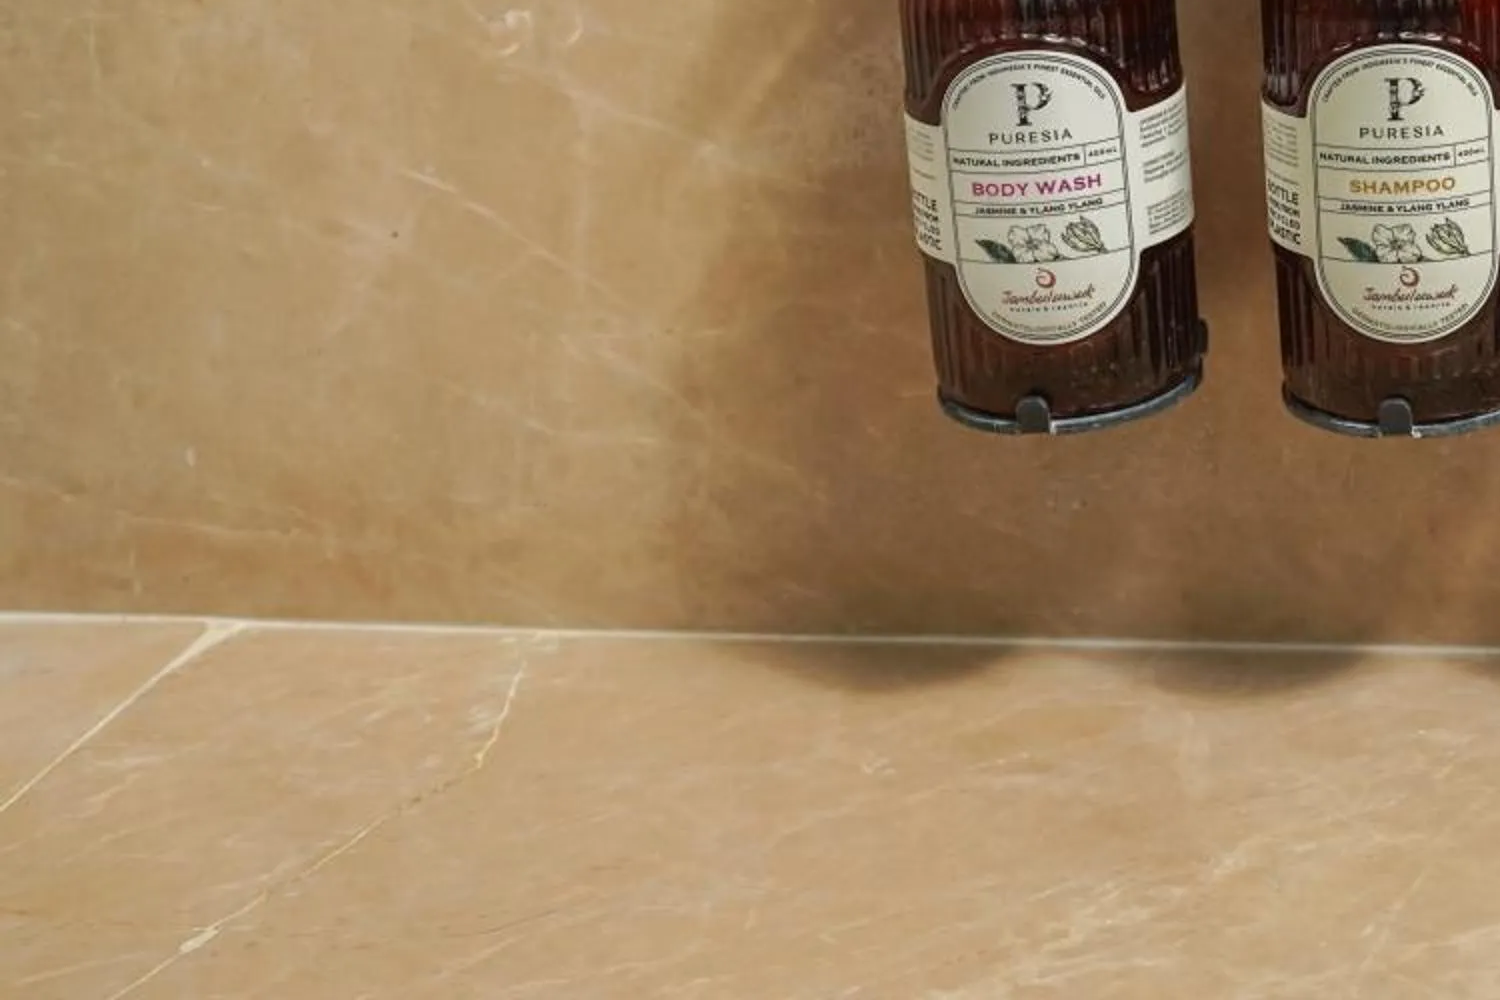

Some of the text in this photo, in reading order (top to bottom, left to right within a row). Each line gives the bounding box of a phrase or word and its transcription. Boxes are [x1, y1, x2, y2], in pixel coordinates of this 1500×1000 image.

[1010, 82, 1052, 127] P
[1384, 77, 1427, 121] P
[989, 128, 1073, 145] PURESIA
[1359, 125, 1445, 140] PURESIA
[953, 157, 998, 167] NATURAL
[1002, 153, 1081, 168] INGREDIENTS
[1319, 152, 1369, 165] NATURAL
[1371, 152, 1450, 165] INGREDIENTS
[972, 173, 1102, 197] BODY WASH
[1350, 177, 1456, 194] SHAMPOO
[975, 198, 1104, 215] JASMINE & YLANG YLANG
[1340, 199, 1471, 213] JASMINE & YLANG YLANG
